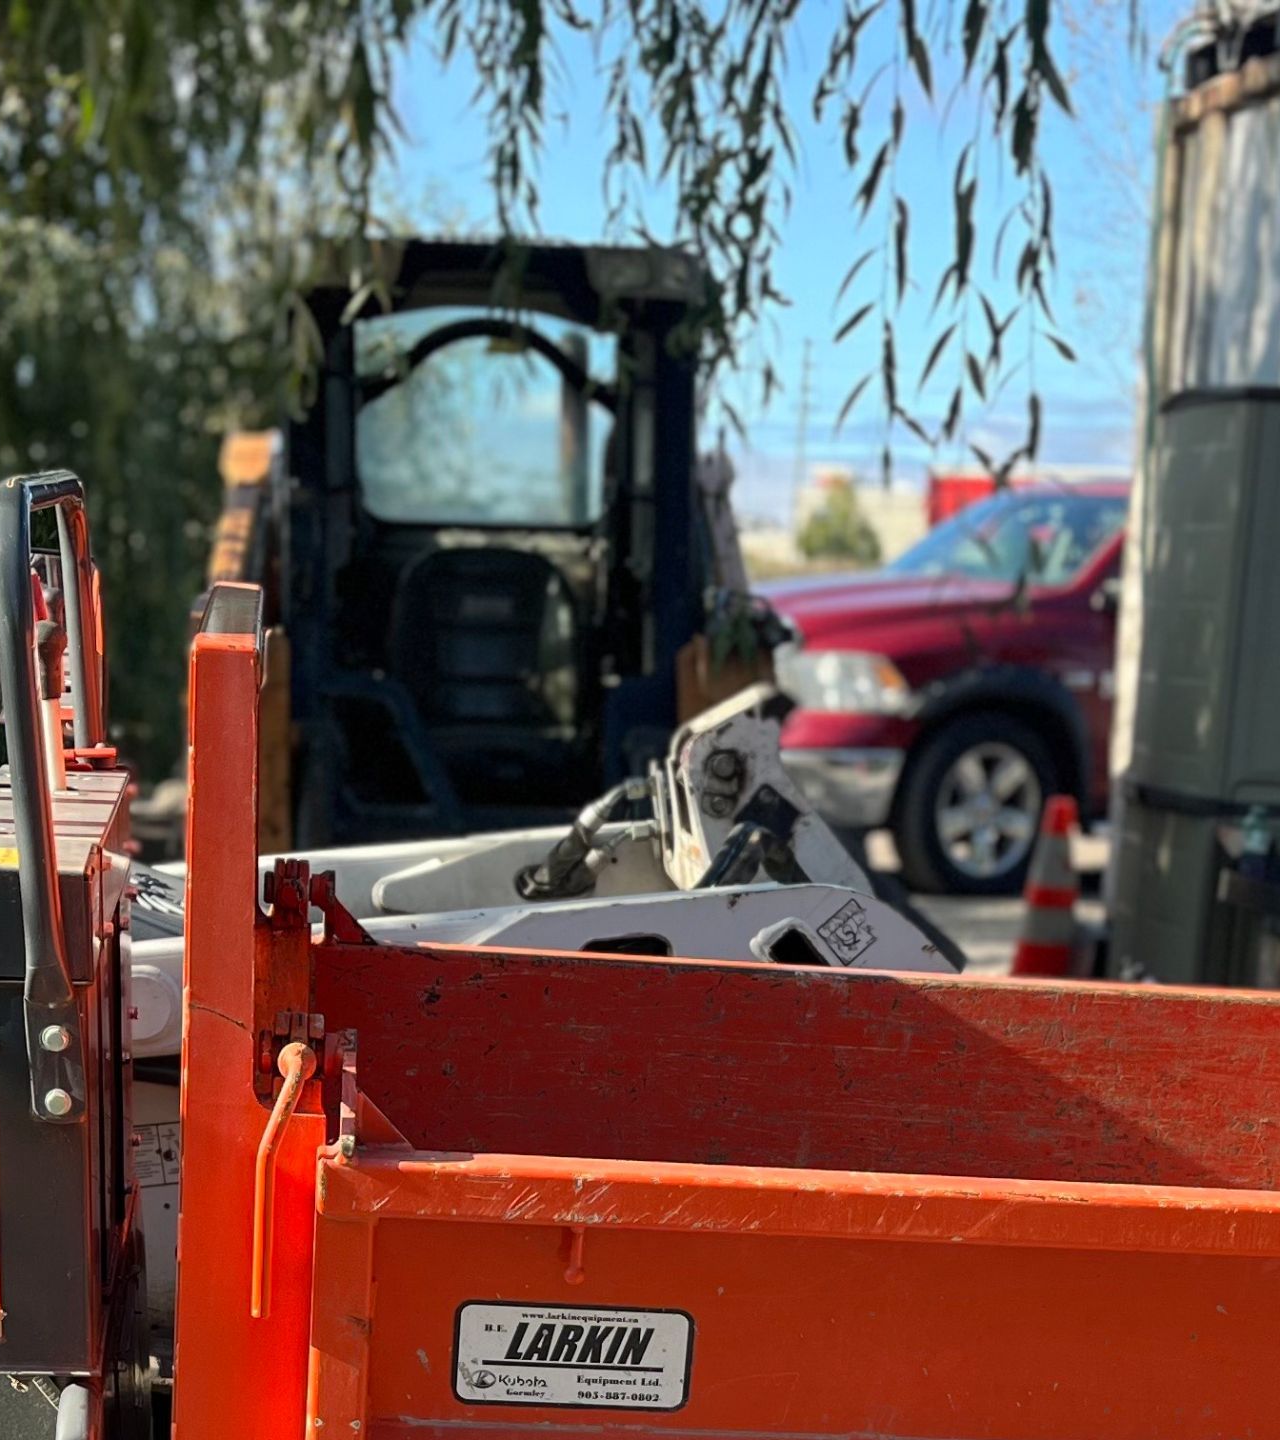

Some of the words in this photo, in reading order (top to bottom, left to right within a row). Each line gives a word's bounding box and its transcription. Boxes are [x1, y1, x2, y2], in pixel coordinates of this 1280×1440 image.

[504, 1321, 656, 1366] LARKIN
[498, 1374, 548, 1388] Kubota
[576, 1374, 637, 1388] Equipment
[640, 1377, 663, 1388] Ltd.
[577, 1390, 660, 1403] 905-887-0802
